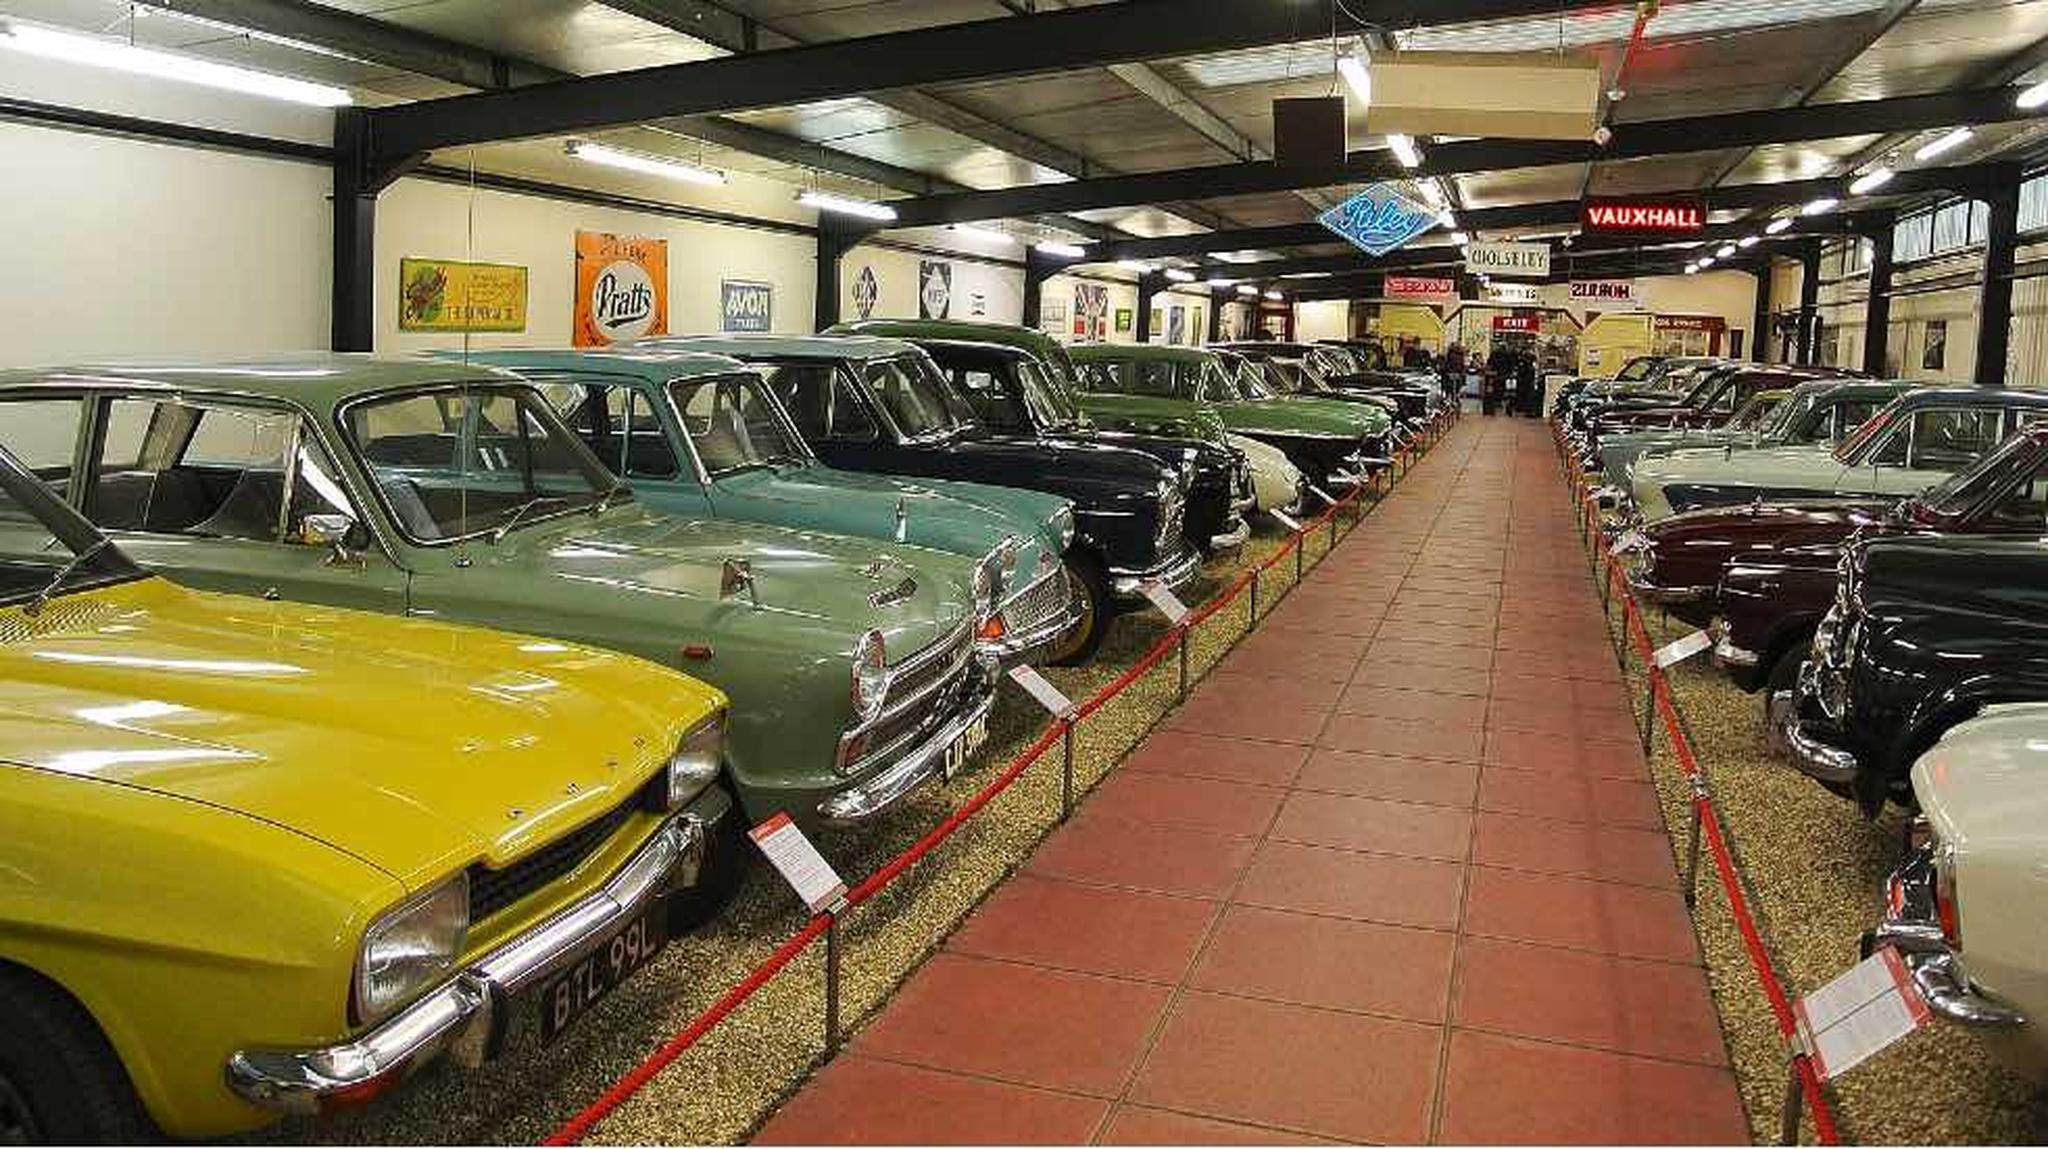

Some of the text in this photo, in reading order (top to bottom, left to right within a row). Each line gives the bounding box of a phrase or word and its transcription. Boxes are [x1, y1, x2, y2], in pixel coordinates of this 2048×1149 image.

[1588, 207, 1701, 226] VAUXHALL
[726, 288, 769, 317] AVON
[554, 916, 656, 1035] BTL 99L
